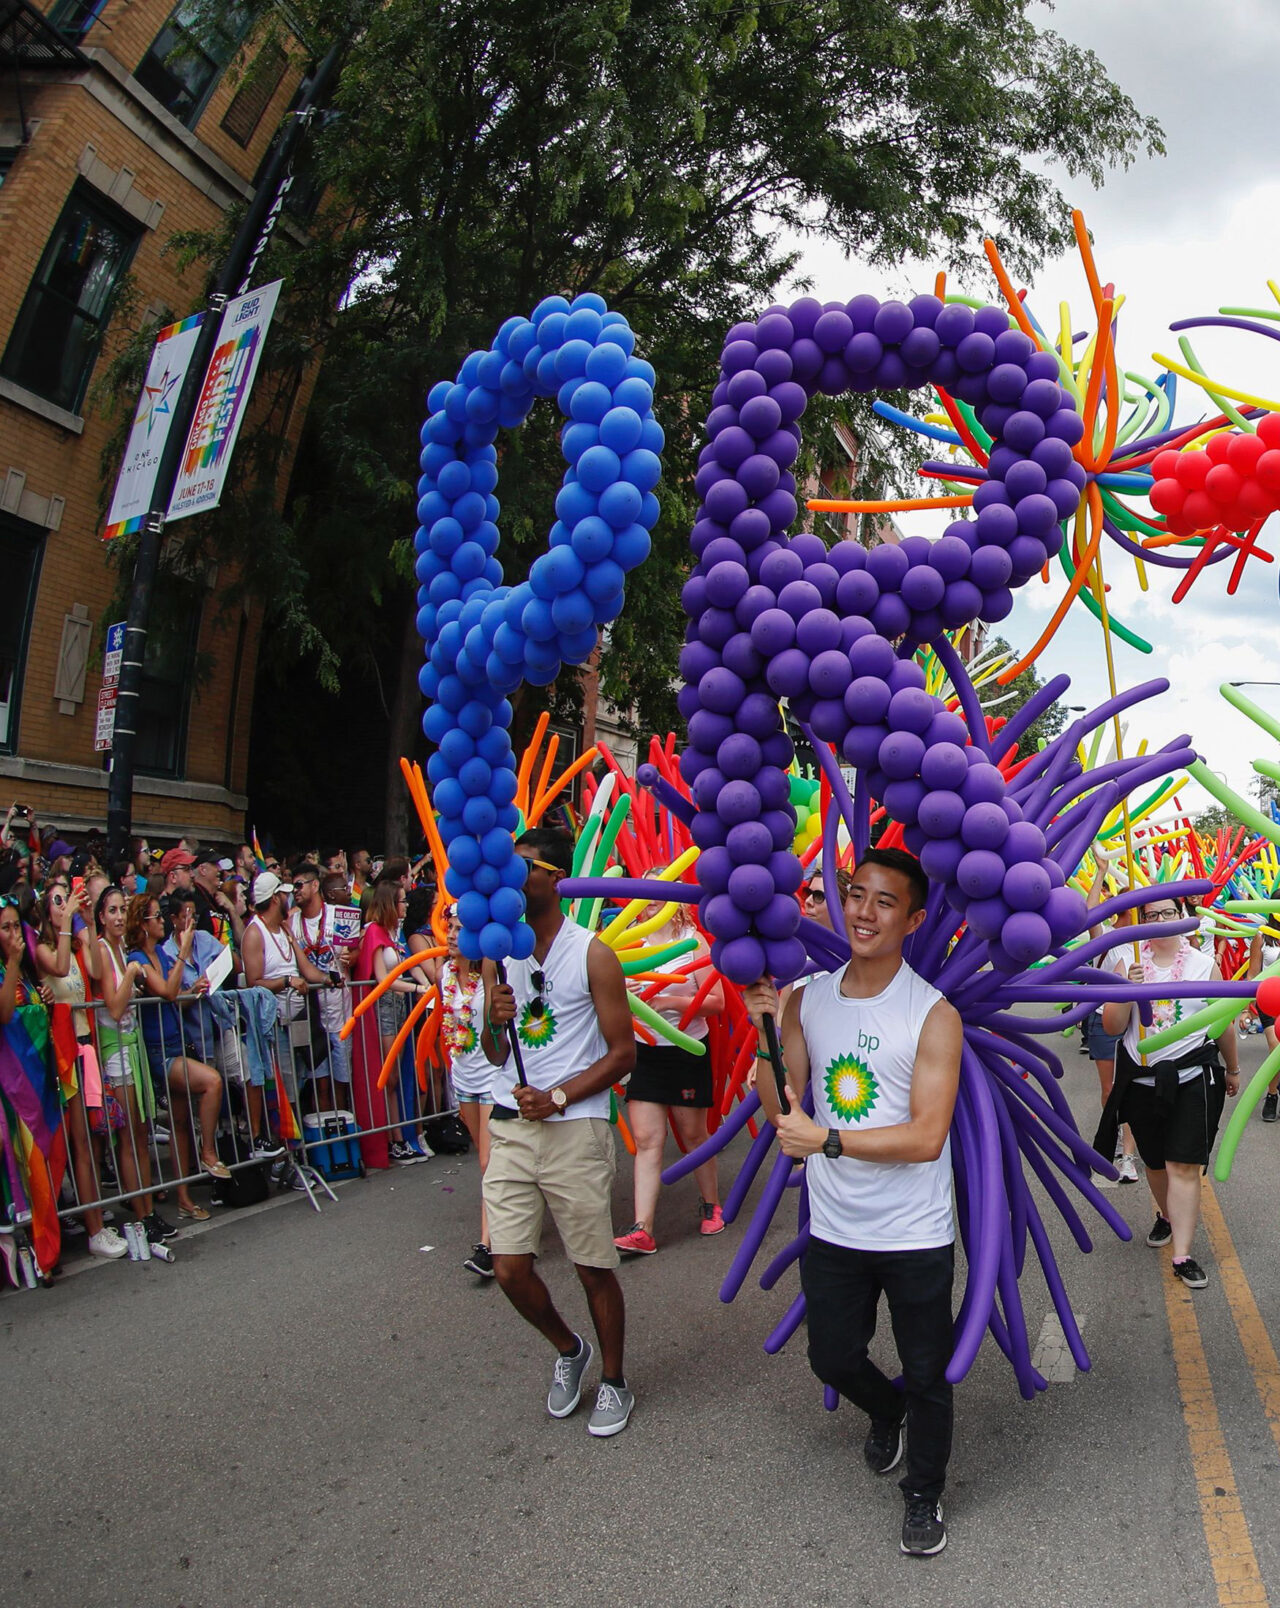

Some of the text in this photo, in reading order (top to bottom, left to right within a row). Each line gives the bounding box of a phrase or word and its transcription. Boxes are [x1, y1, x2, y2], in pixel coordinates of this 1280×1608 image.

[241, 297, 260, 312] BUD
[235, 305, 261, 323] LIGHT
[197, 353, 236, 447] PRIDE
[190, 401, 209, 449] CHICAGO
[135, 449, 151, 461] ONE
[121, 456, 159, 474] CHICAGO
[179, 483, 198, 500] JUNE
[857, 1028, 880, 1054] bp
